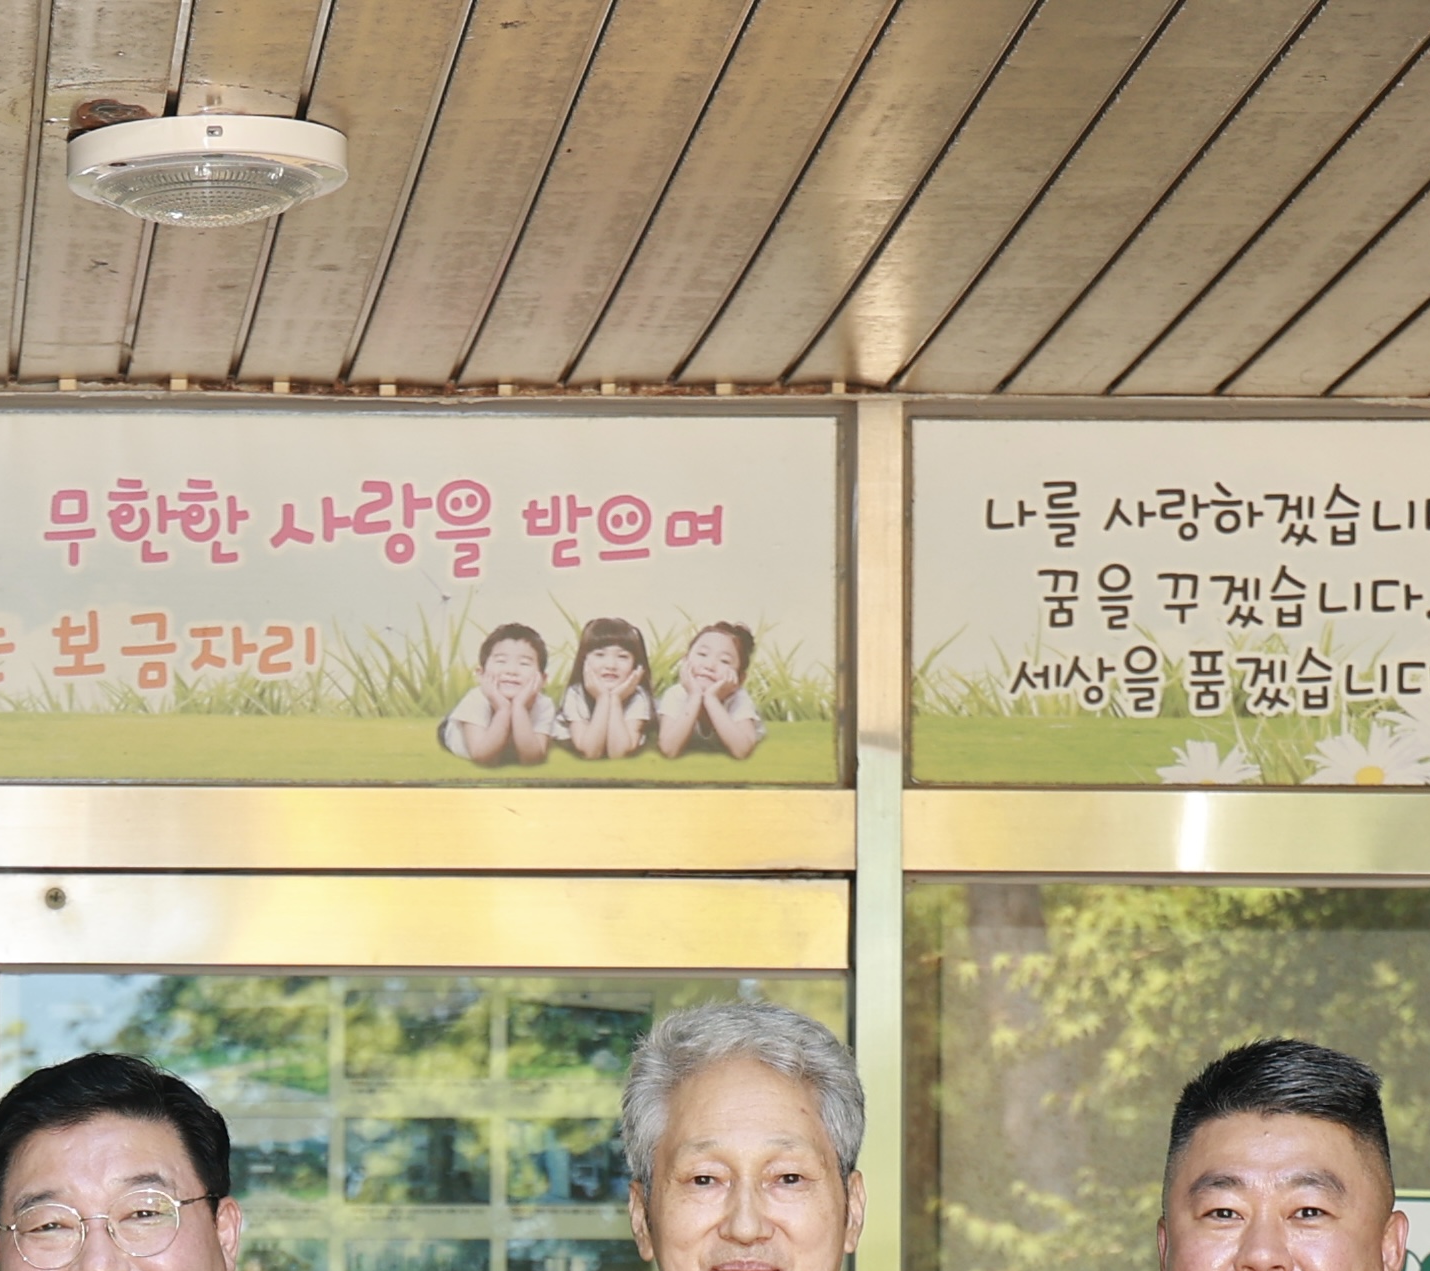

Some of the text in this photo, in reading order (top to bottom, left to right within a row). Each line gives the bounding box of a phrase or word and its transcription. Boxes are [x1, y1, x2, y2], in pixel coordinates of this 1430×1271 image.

[45, 478, 248, 565] 무한한
[269, 478, 493, 578] 사랑을
[522, 493, 724, 568] 받으며
[985, 482, 1081, 547] 나를
[1038, 564, 1133, 629] 꿈을
[52, 609, 317, 688] 보금자리
[1011, 646, 1161, 712] 세상을
